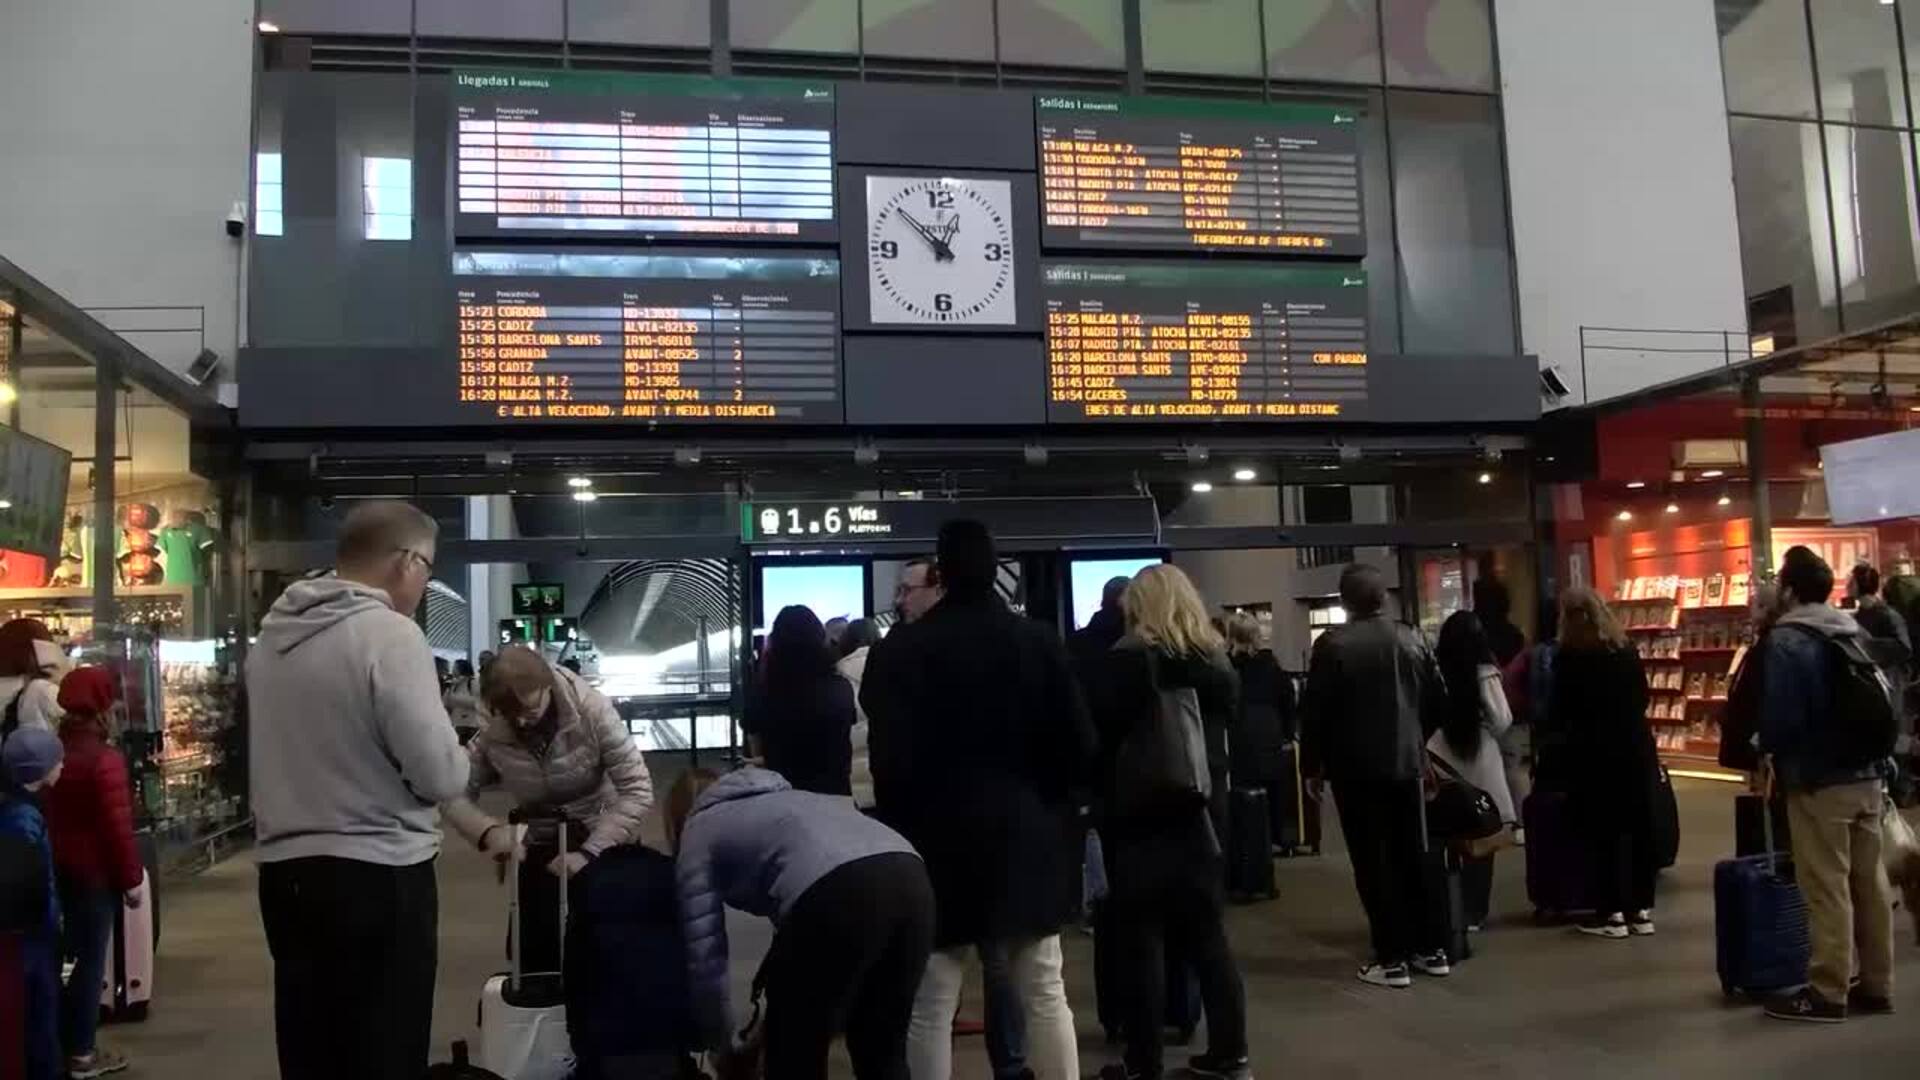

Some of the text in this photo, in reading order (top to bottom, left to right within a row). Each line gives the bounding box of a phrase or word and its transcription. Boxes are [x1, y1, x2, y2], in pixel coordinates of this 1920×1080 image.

[458, 75, 507, 87] Llegadas
[1040, 98, 1075, 109] Salidas
[926, 190, 955, 209] 12
[880, 240, 1001, 261] 9 3
[1046, 270, 1081, 280] Salidas
[934, 294, 952, 312] 6
[460, 306, 494, 317] 15:21
[498, 306, 547, 317] CORDOBA
[460, 319, 495, 331] 15:25
[498, 320, 534, 331] CADIZ
[1049, 313, 1079, 324] 15:25
[1081, 313, 1117, 325] MALAGA
[1082, 326, 1118, 337] MADRID
[1151, 327, 1187, 338] ATOCHA
[460, 333, 495, 345] 15:36
[498, 333, 561, 345] BARCELONA
[566, 334, 602, 345] SANTS
[1082, 338, 1119, 349] MADRID
[1152, 339, 1187, 350] ATOCHA
[460, 347, 496, 359] 15:56
[499, 347, 548, 359] GRANADA
[734, 350, 742, 360] 2
[1083, 352, 1137, 363] BARCELONA
[1142, 352, 1171, 363] SANTS
[499, 361, 534, 373] CADIZ
[1083, 364, 1137, 376] BARCELONA
[1142, 364, 1172, 376] SANTS
[460, 375, 496, 387] 16:17
[499, 375, 541, 386] MALAGA
[1052, 377, 1083, 388] 16:45
[1084, 377, 1115, 388] CADIZ
[499, 389, 541, 400] MALAGA
[734, 390, 743, 401] 2
[1052, 389, 1083, 400] 16:54
[1085, 390, 1127, 400] CACERES
[512, 405, 542, 416] ALTA
[622, 405, 658, 417] AVANT
[664, 405, 671, 416] Y
[676, 405, 711, 417] MEDIA
[716, 405, 776, 417] DISTANCIA
[1114, 404, 1126, 415] DE
[1131, 404, 1155, 415] ALTA
[1222, 404, 1250, 415] AVANT
[1256, 404, 1262, 415] Y
[1266, 404, 1295, 415] MEDIA
[787, 507, 804, 534] 1
[824, 506, 841, 533] 6
[501, 630, 511, 643] 5
